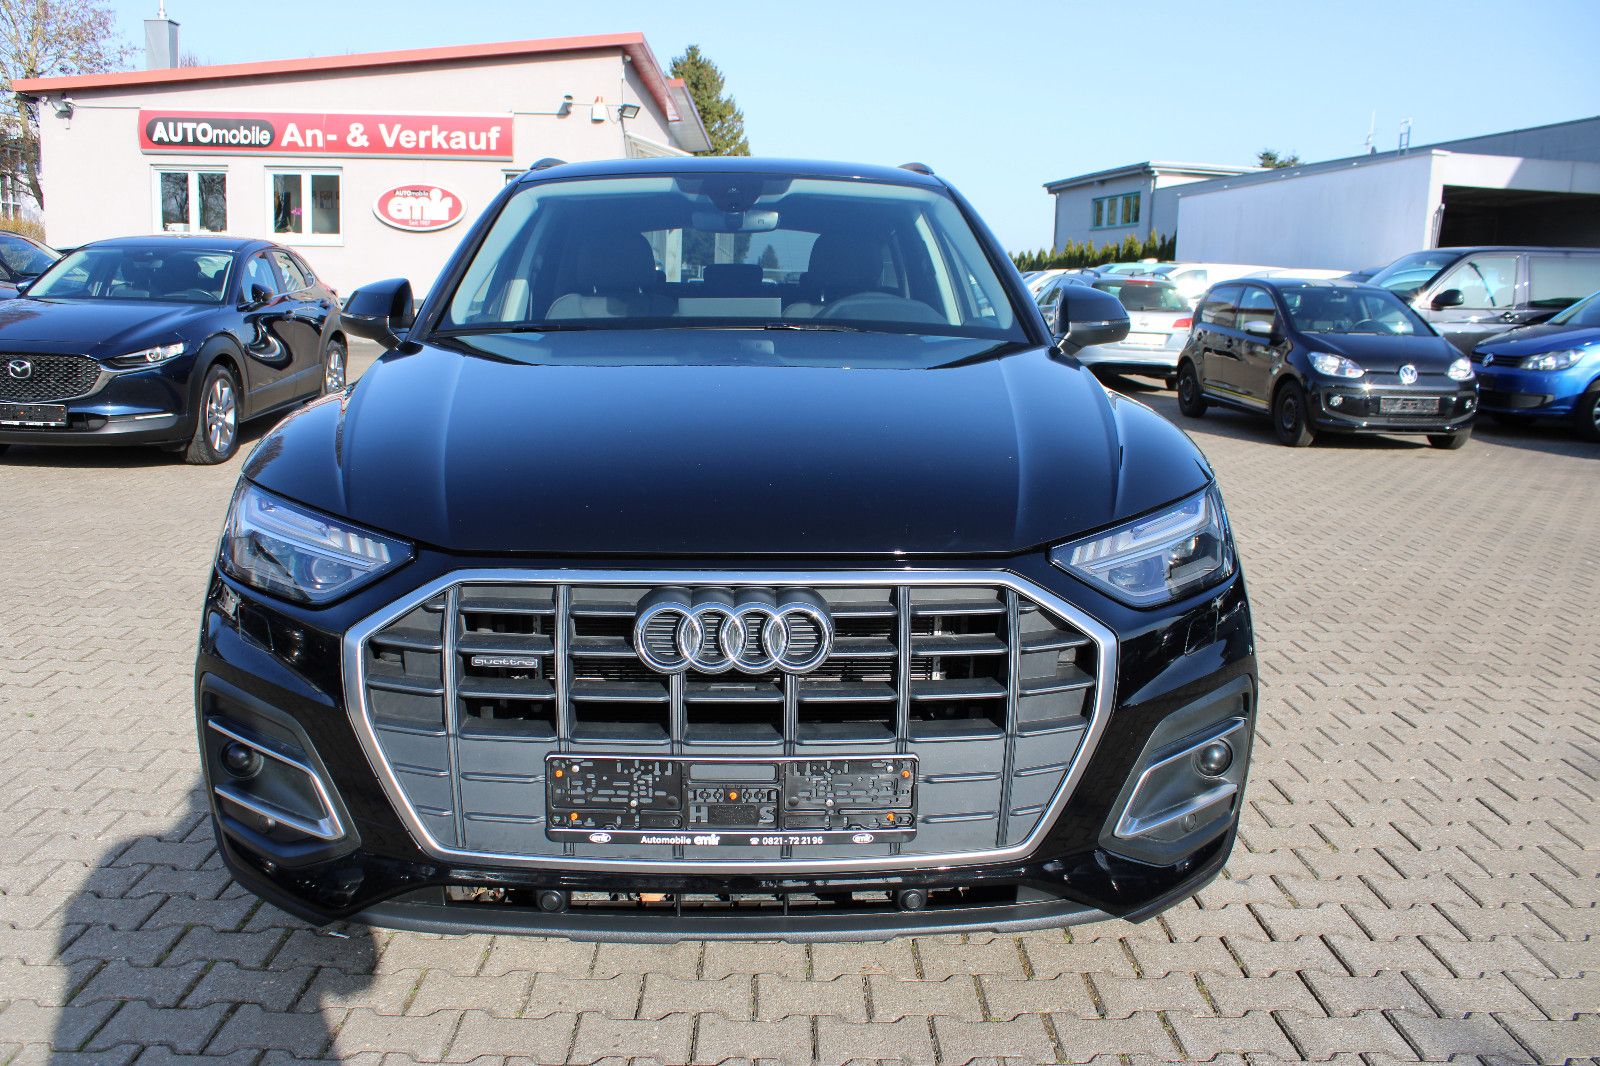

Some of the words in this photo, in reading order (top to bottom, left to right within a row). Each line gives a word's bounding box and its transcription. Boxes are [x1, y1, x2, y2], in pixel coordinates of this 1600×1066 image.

[152, 121, 271, 145] AUTOmobile
[280, 122, 338, 148] An-
[346, 122, 370, 148] &
[377, 123, 502, 151] Verkauf
[387, 188, 453, 221] emir
[640, 835, 692, 845] Automobile
[693, 834, 720, 846] emir
